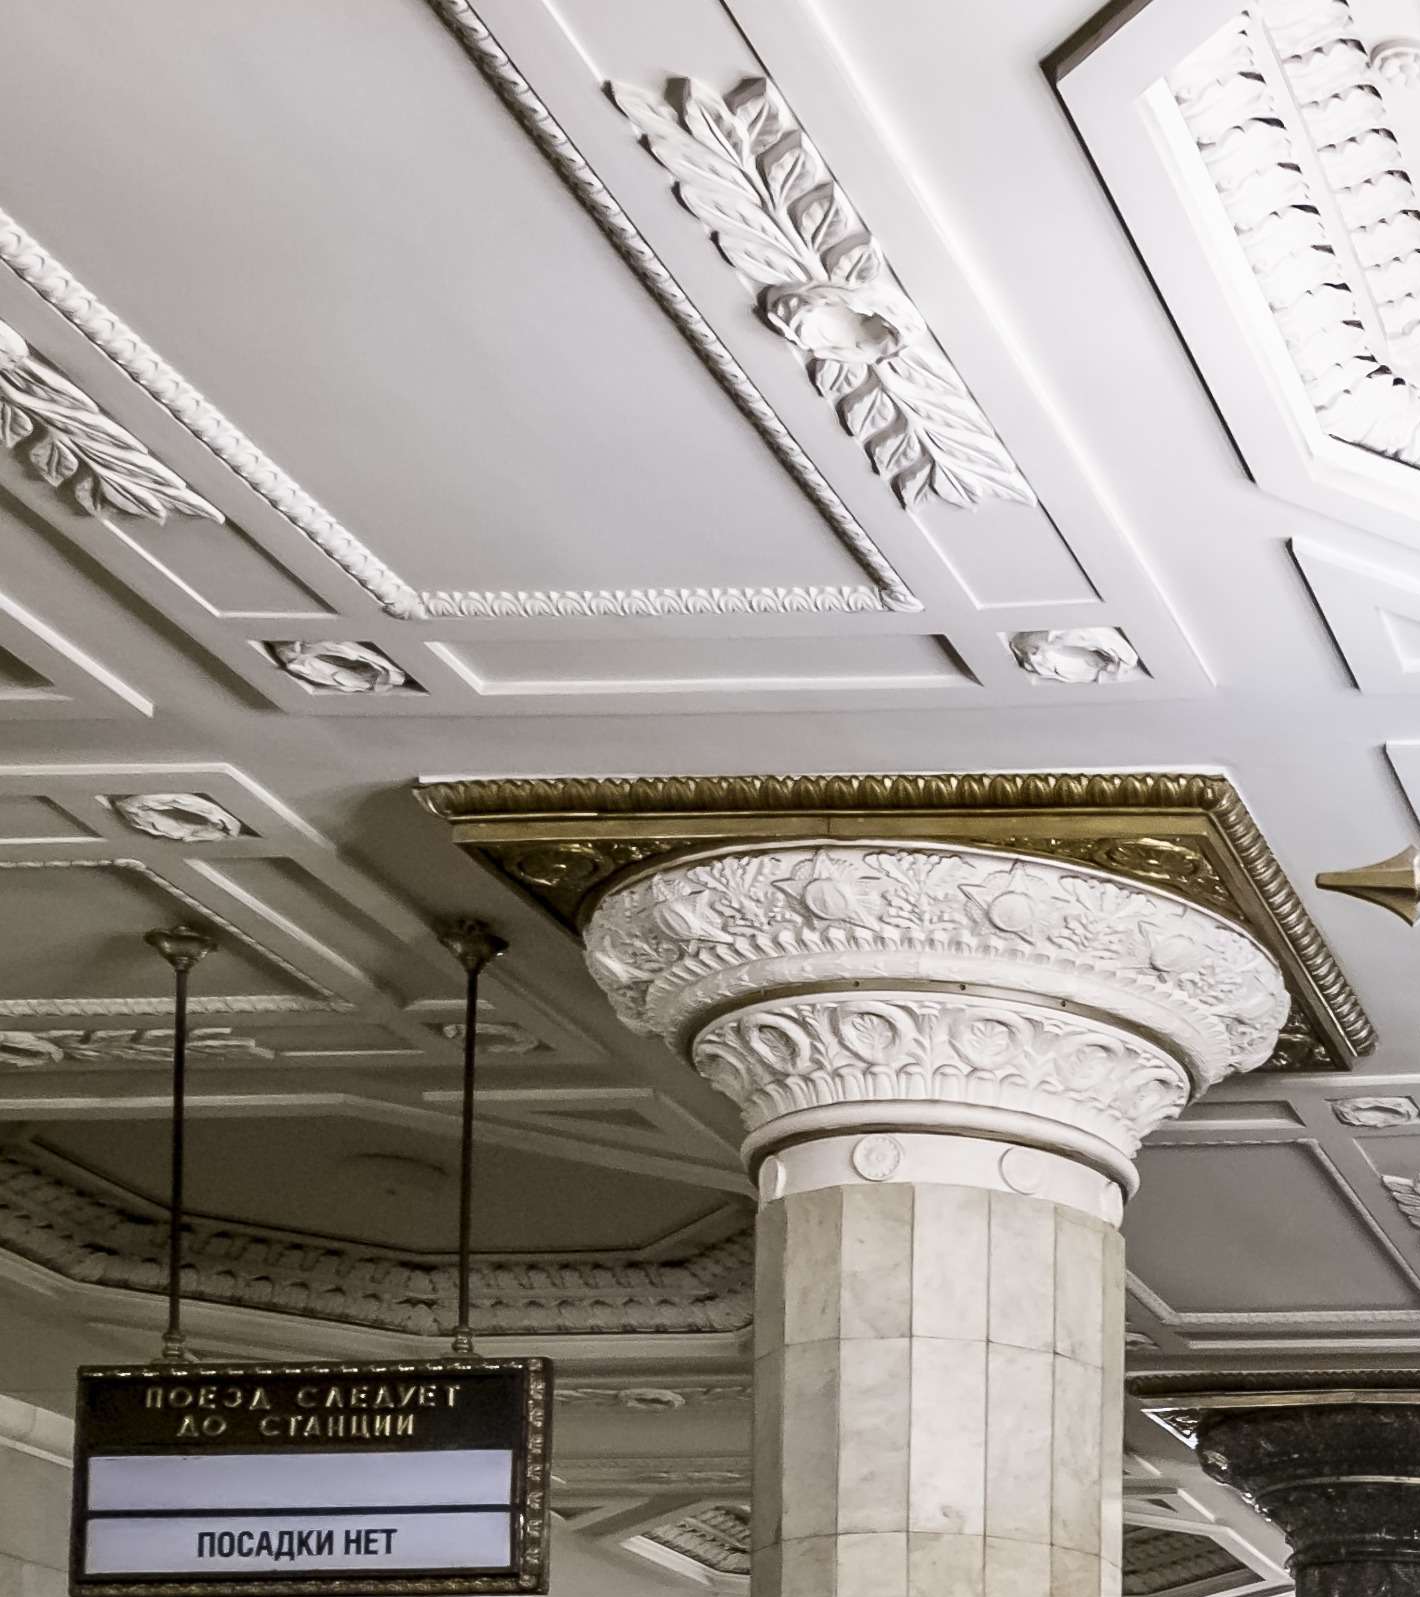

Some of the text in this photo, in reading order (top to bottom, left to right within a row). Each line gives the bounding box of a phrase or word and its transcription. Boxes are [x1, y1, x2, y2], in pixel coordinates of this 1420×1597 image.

[144, 1383, 463, 1411] ПОЕЗД СЛЕДУЕТ
[176, 1412, 416, 1440] ДО СТАНЦИИ
[197, 1528, 398, 1561] ПОСАДКИ НЕТ
